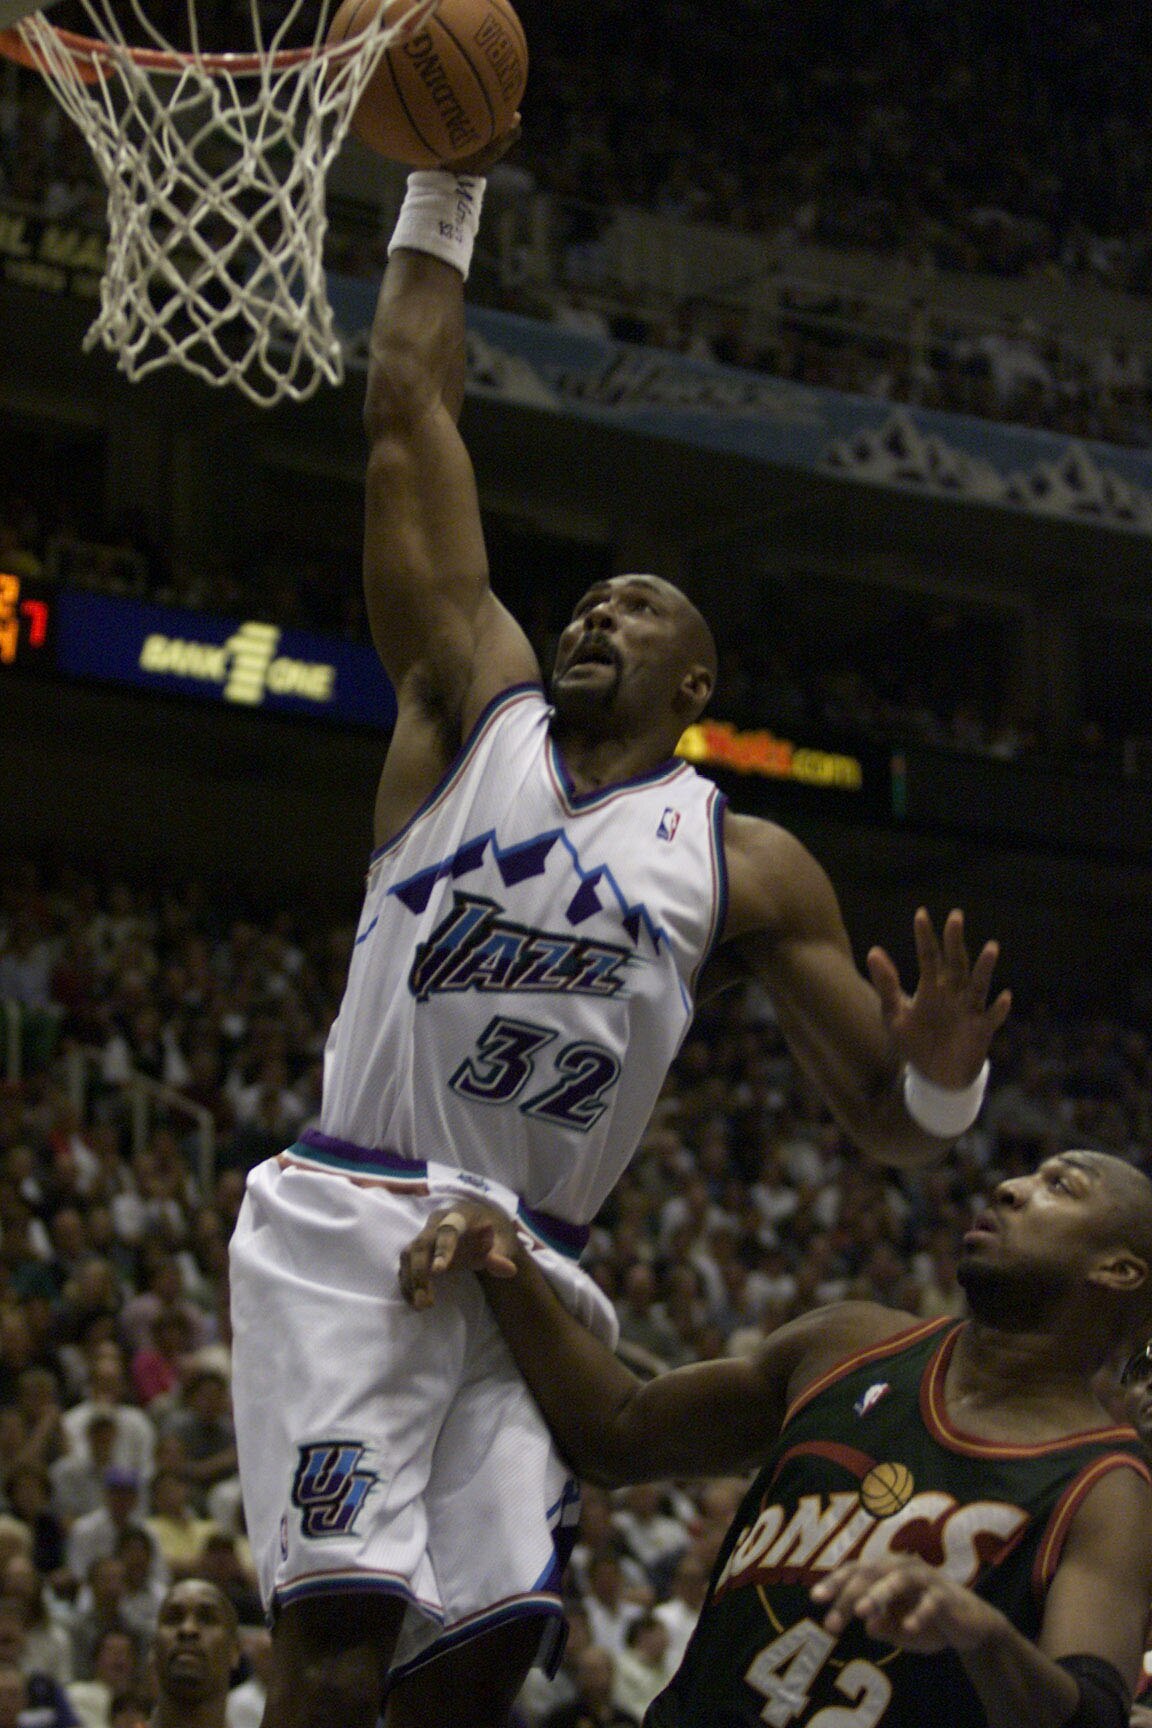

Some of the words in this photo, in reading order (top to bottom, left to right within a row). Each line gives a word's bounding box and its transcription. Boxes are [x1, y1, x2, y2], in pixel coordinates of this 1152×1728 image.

[401, 32, 479, 150] PALDING
[409, 891, 632, 1002] JAZZ
[448, 1015, 622, 1133] 32
[743, 1616, 893, 1728] 42
